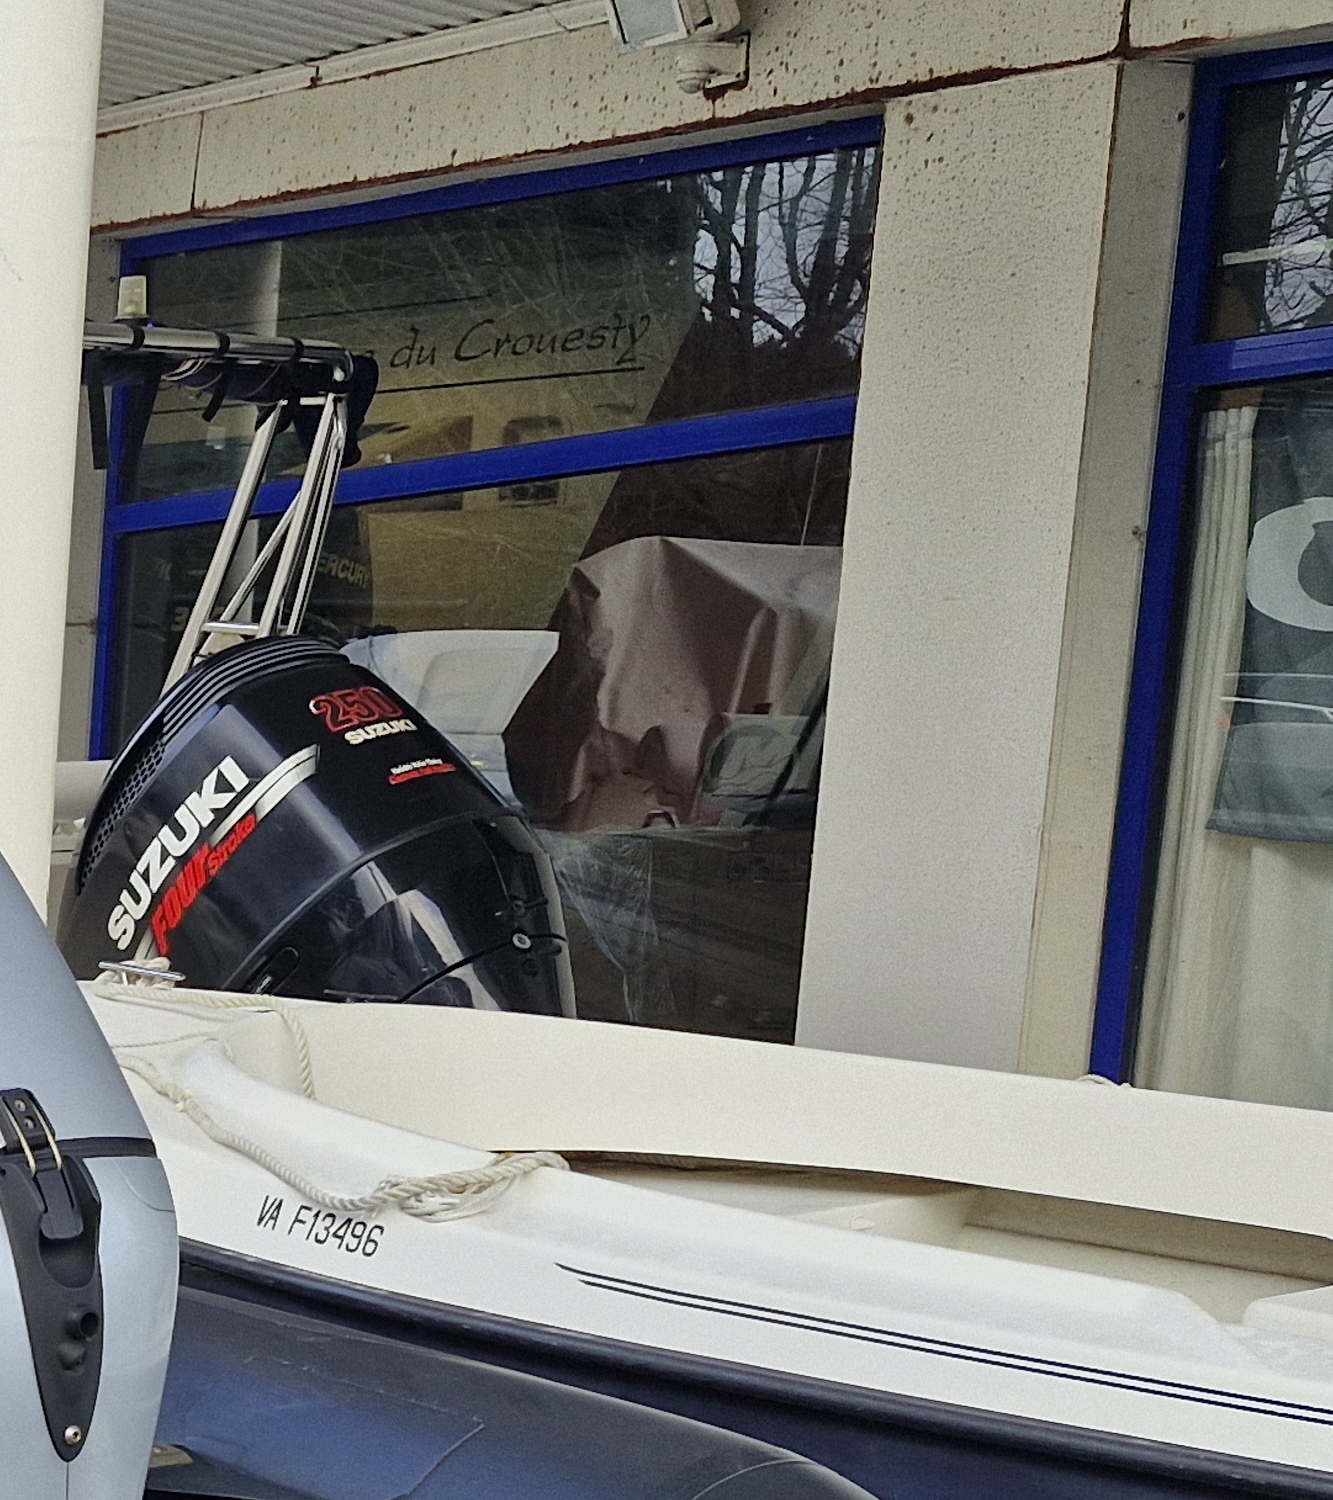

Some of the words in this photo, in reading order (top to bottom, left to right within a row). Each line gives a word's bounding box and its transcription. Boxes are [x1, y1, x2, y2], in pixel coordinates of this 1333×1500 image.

[389, 324, 436, 368] du
[453, 313, 651, 366] Crouesty
[308, 685, 404, 733] 250
[344, 718, 419, 745] SUZUKI
[107, 754, 251, 951] SUZUKI
[256, 1194, 284, 1231] VA
[287, 1204, 385, 1257] F13496
